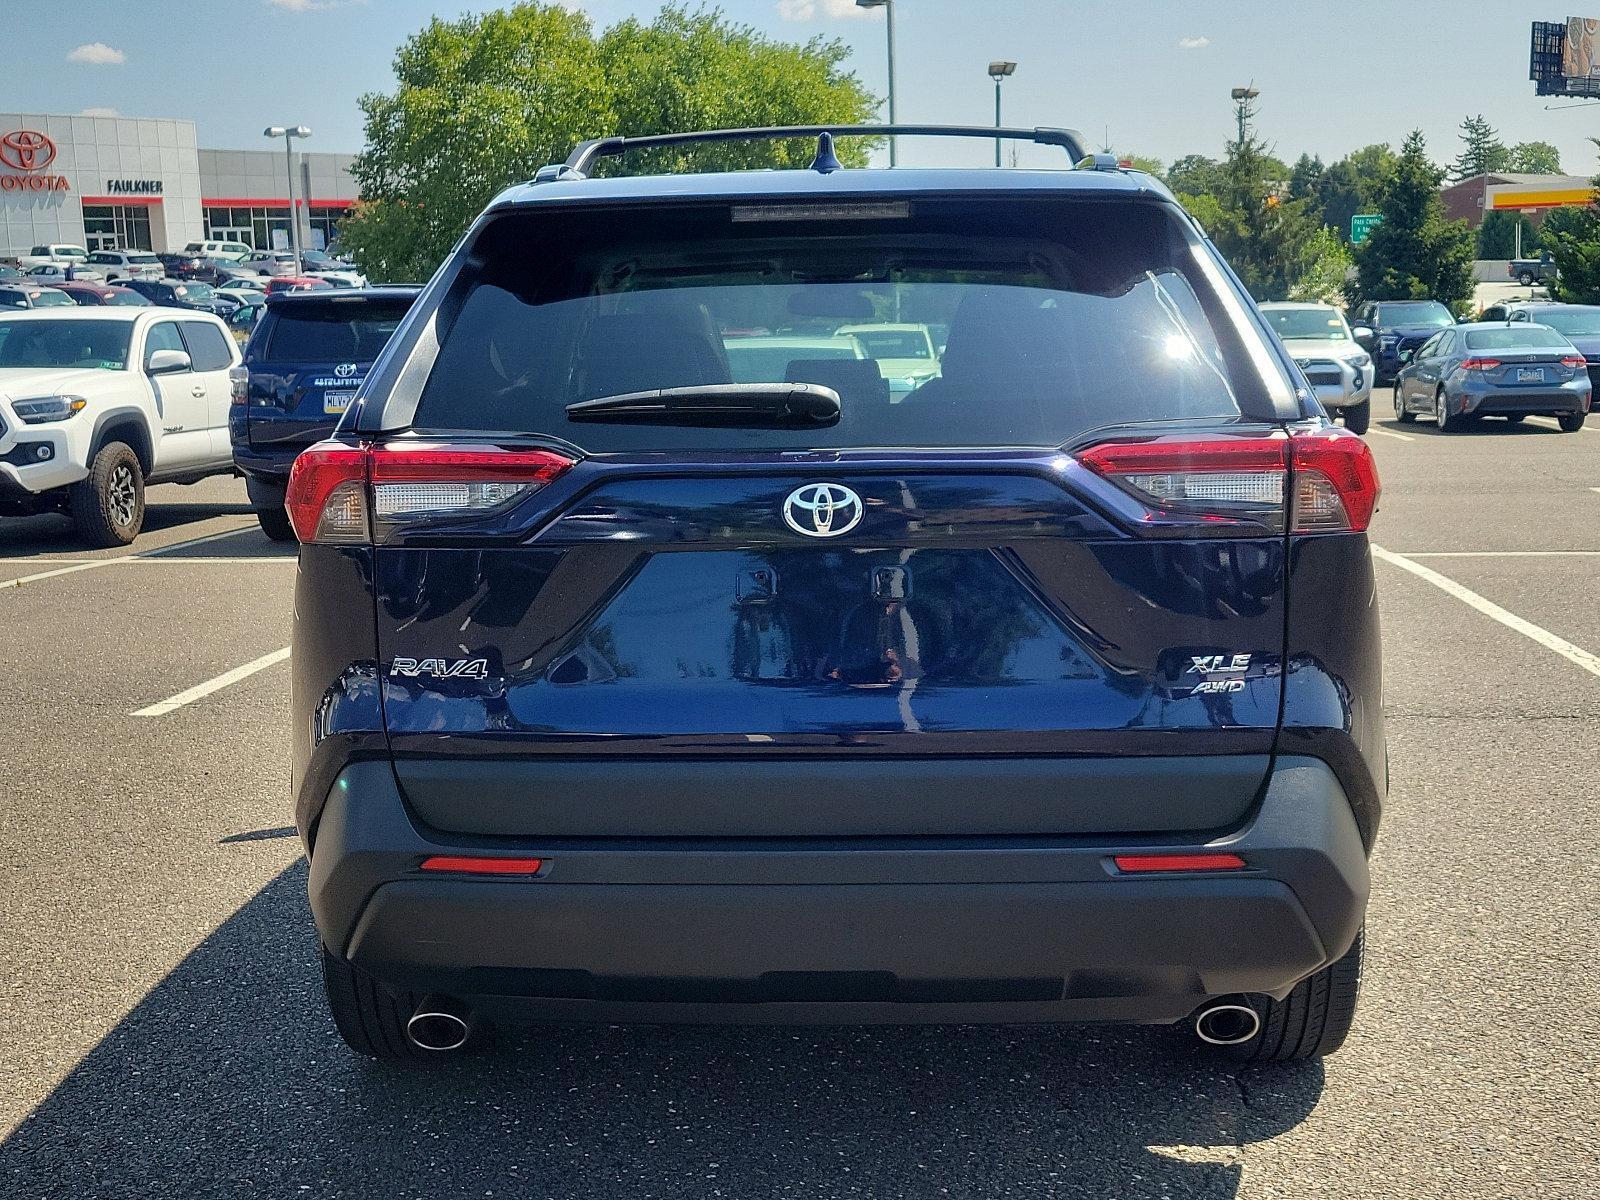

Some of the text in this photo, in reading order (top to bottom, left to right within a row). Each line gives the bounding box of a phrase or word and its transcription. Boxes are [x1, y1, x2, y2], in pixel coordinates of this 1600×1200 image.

[107, 179, 163, 193] FAULKNER
[314, 378, 363, 386] 4RUNNE
[390, 657, 488, 679] RAV4
[1186, 654, 1252, 674] XLE
[1190, 680, 1245, 694] AWD
